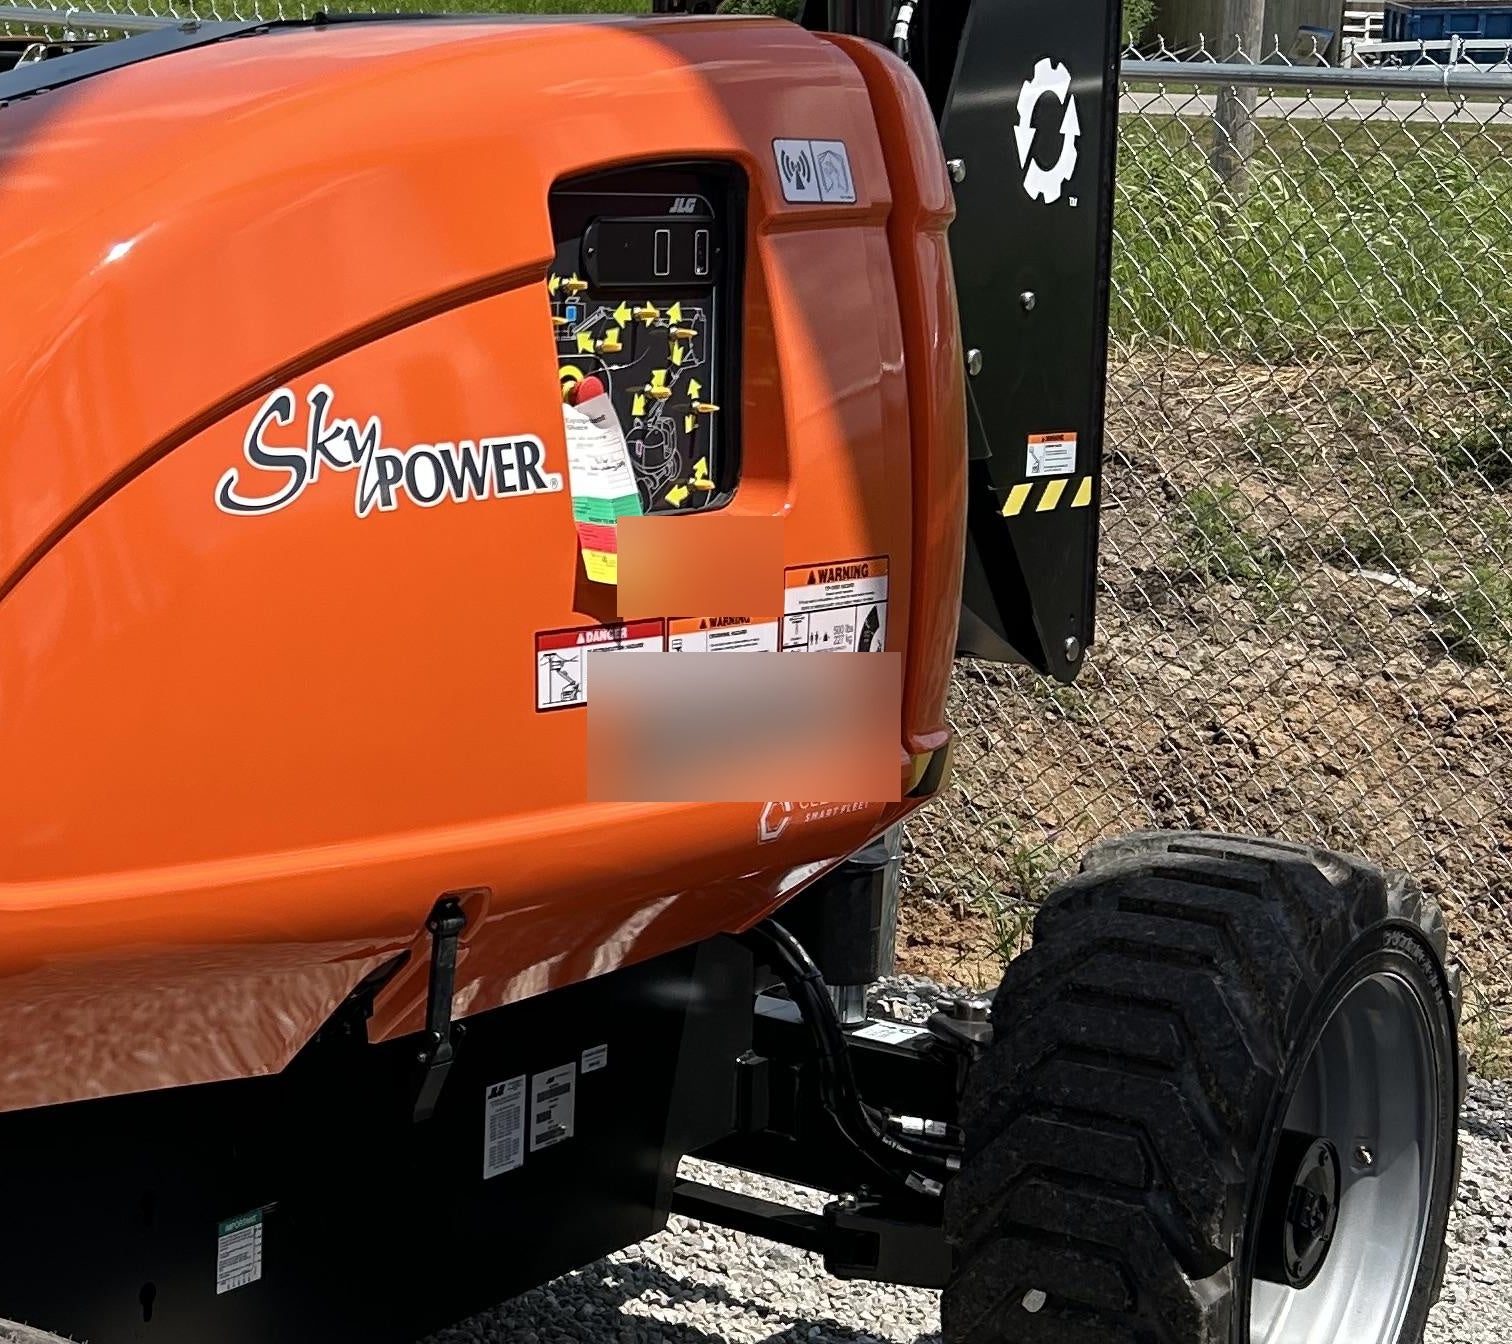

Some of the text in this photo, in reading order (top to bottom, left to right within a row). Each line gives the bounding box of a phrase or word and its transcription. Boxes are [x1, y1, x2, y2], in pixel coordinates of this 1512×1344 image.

[669, 198, 697, 213] JLG
[374, 439, 549, 508] POWER
[818, 564, 869, 584] WARNING
[586, 626, 627, 644] DANGER
[804, 806, 838, 823] SMART
